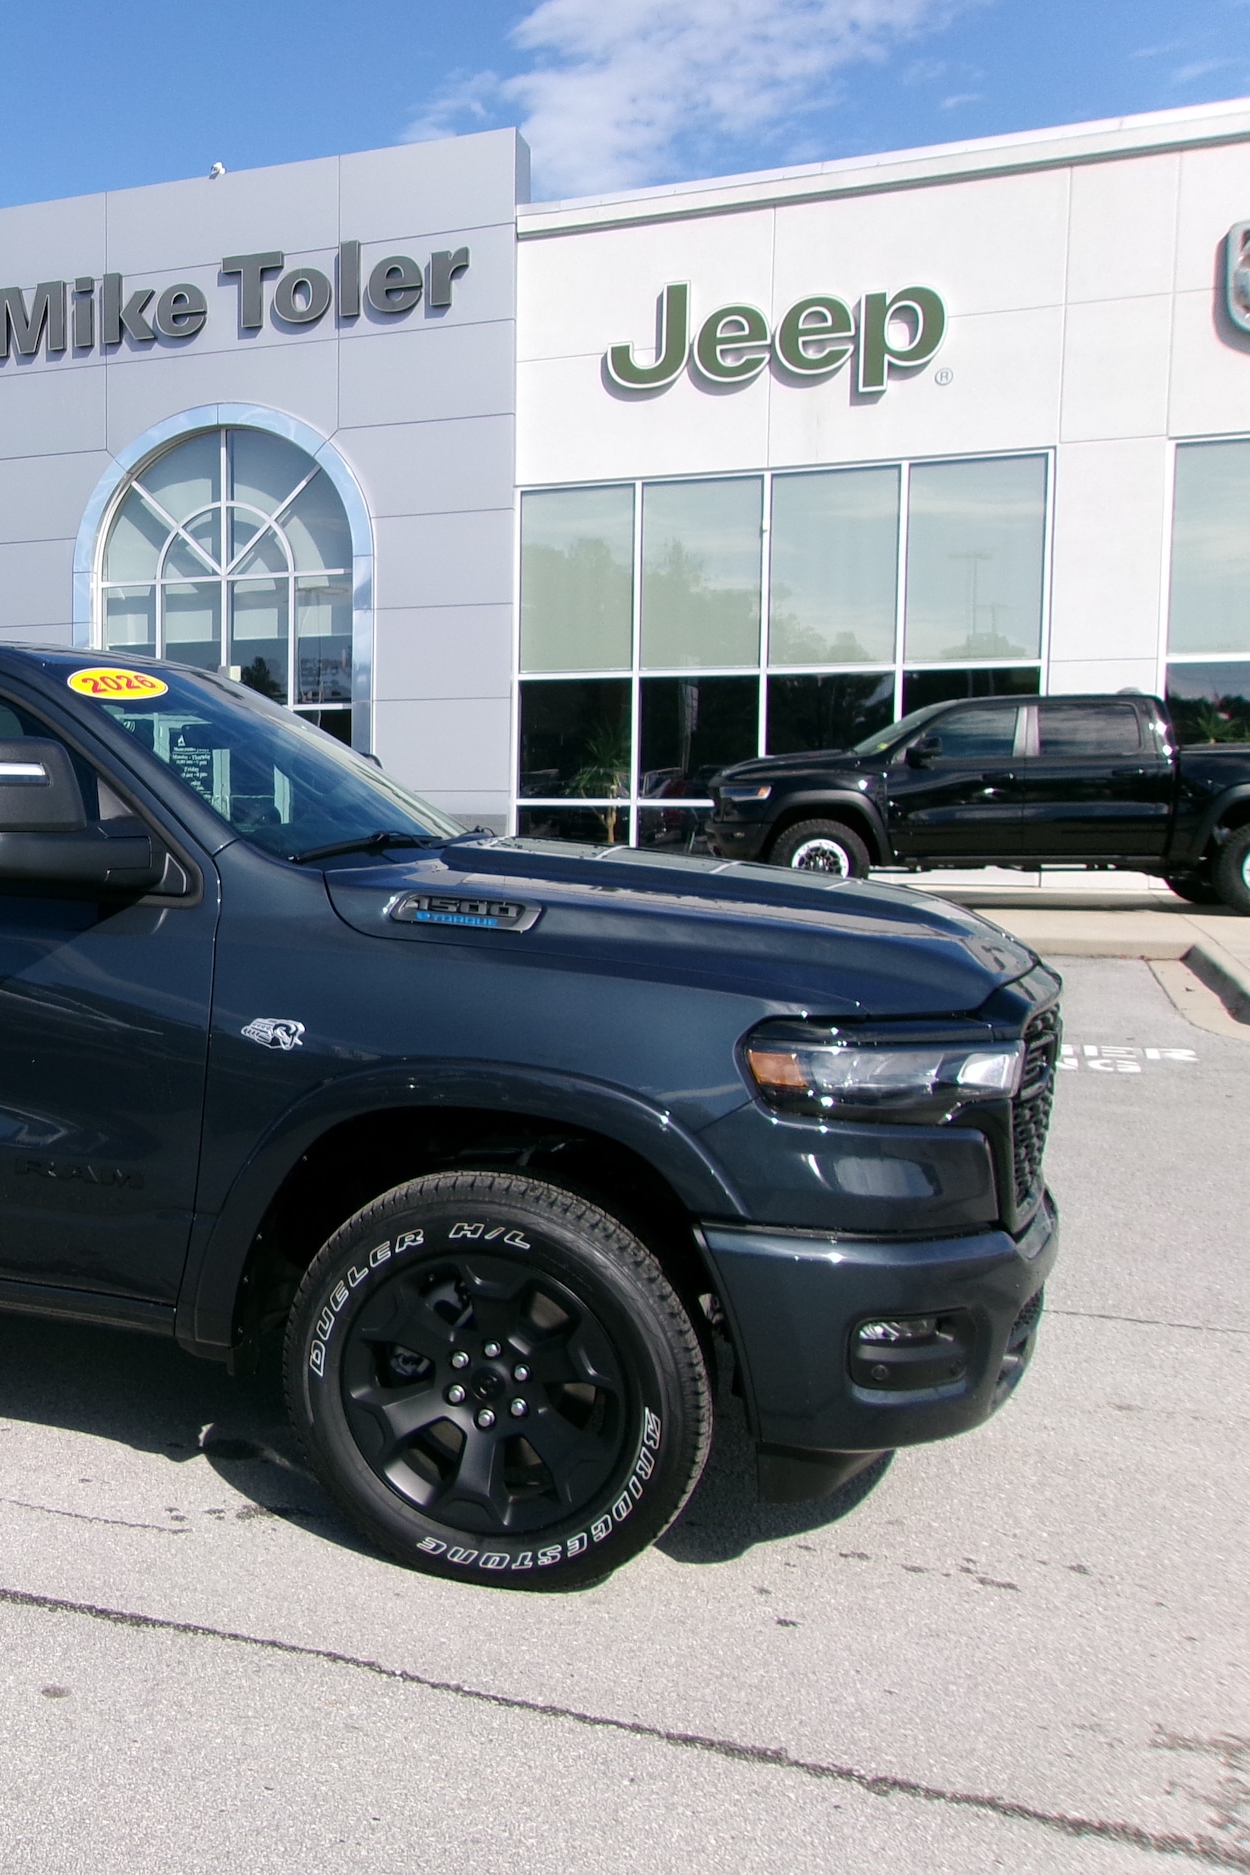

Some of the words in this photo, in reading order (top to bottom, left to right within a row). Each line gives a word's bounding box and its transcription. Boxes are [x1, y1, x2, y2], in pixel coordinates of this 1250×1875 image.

[221, 239, 470, 330] Toler
[606, 279, 948, 393] Jeep
[81, 674, 157, 694] 2026
[404, 896, 518, 918] 1500
[15, 1158, 146, 1190] RAM
[309, 1229, 425, 1378] DUELER
[448, 1222, 532, 1250] H/L
[417, 1406, 662, 1571] BRIDGESTONE
